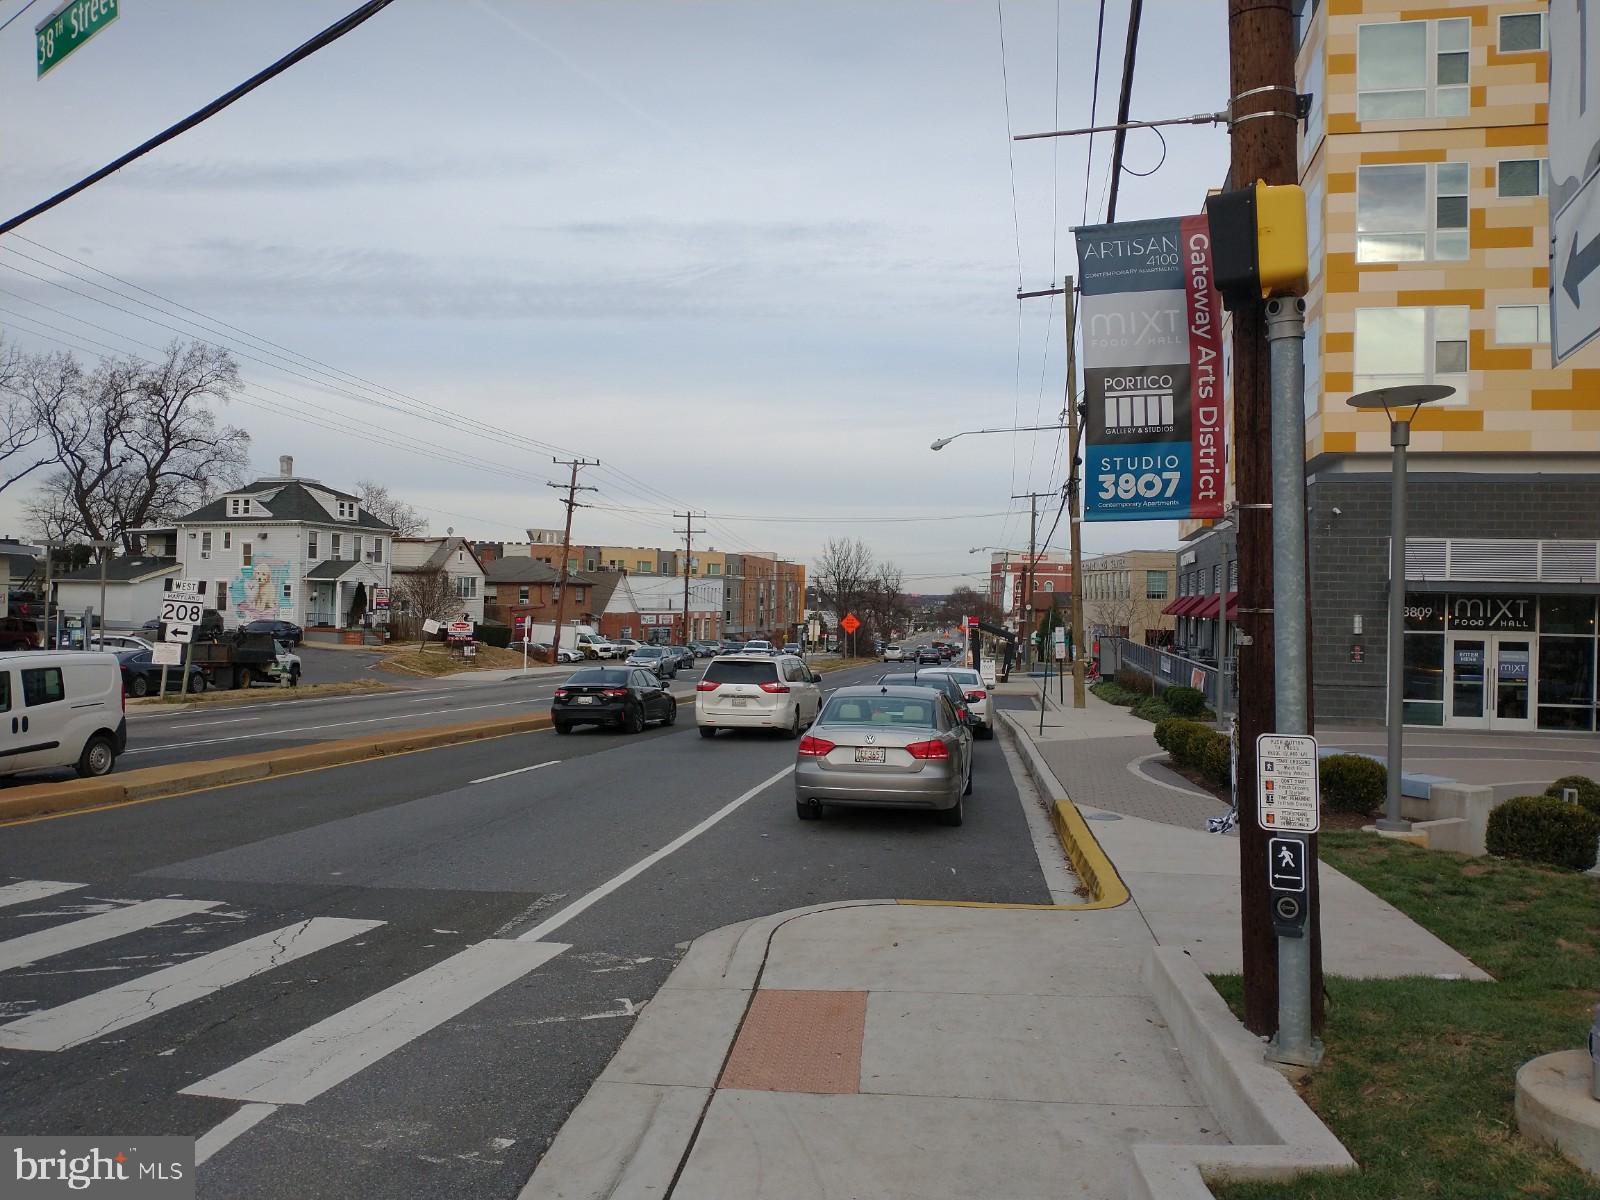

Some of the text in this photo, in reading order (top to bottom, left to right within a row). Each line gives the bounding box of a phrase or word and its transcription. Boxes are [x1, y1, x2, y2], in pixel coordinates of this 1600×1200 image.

[71, 0, 115, 39] Stree
[1084, 234, 1178, 260] ARTISAN
[1146, 253, 1179, 266] 4100
[1091, 337, 1128, 347] FOOD
[1189, 233, 1221, 500] Gateway Arts District
[1104, 375, 1173, 390] PORTICO
[1105, 425, 1174, 435] GALLERY & STUDIOS
[1101, 455, 1179, 471] STUDIO
[1098, 471, 1181, 500] 3807
[1143, 499, 1180, 508] Apartments
[175, 581, 196, 591] WEST
[162, 603, 201, 622] 208
[1403, 606, 1433, 618] 3809
[1454, 619, 1529, 628] FOOD HALL
